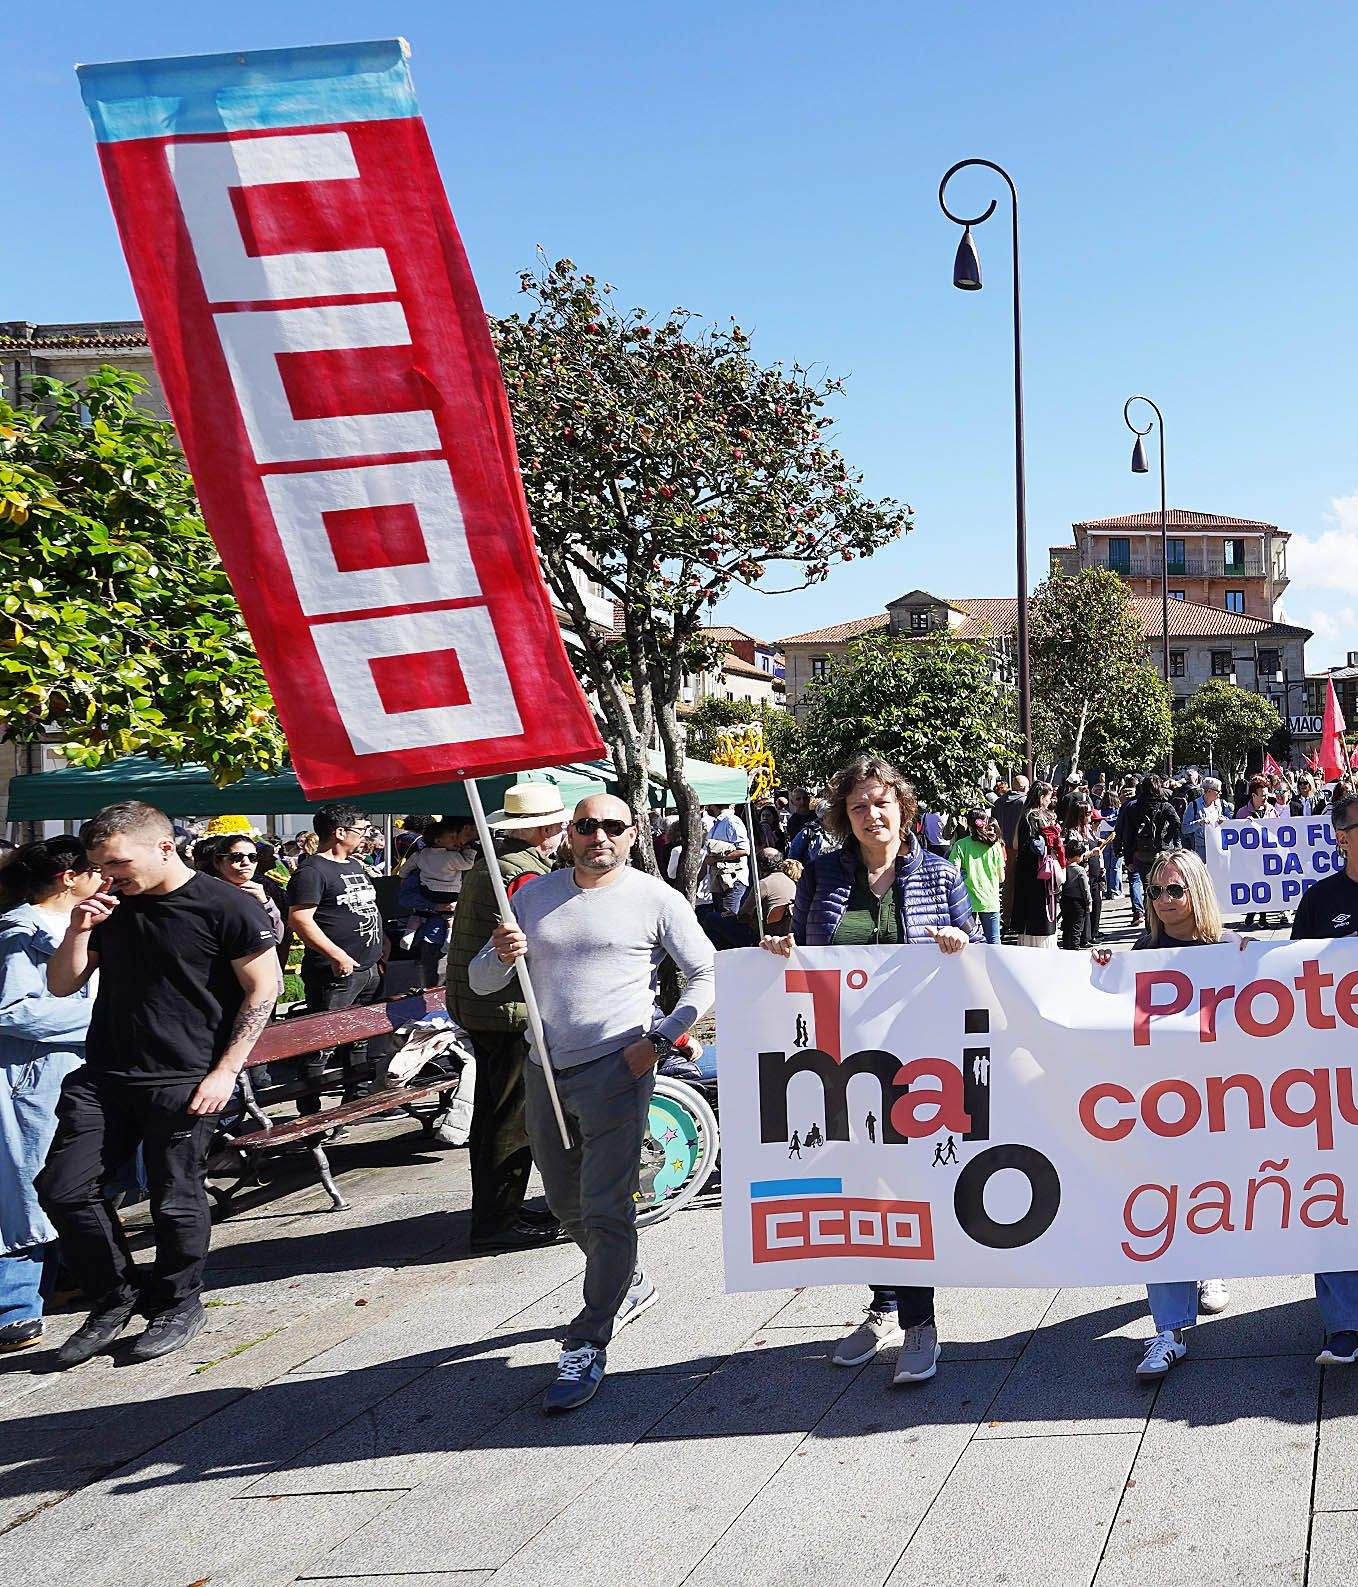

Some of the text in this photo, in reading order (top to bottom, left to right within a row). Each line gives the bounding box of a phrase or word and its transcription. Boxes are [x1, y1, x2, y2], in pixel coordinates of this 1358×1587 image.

[163, 131, 524, 755] CCOO
[1221, 824, 1336, 850] POLO FU
[1262, 850, 1347, 876] DA CO
[1230, 881, 1271, 905] DO
[765, 1209, 922, 1249] CCOO
